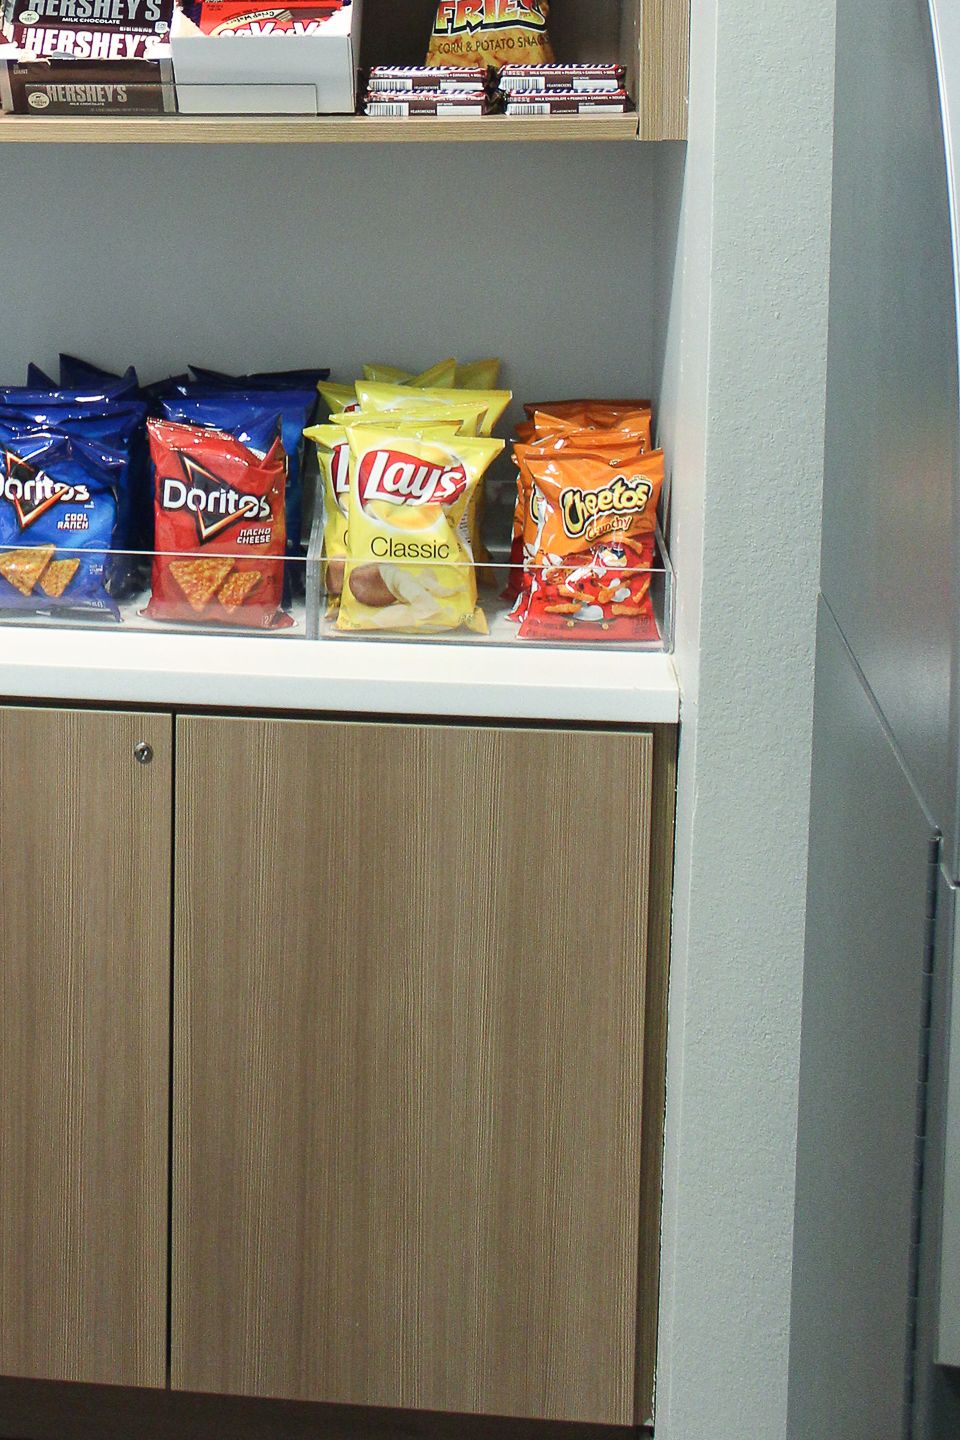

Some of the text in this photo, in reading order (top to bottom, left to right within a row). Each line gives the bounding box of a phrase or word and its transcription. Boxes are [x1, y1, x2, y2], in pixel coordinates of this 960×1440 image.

[25, 27, 163, 60] HERSHEY'S
[437, 41, 463, 54] CORN
[465, 41, 473, 53] &
[475, 38, 515, 52] POTATO
[46, 85, 127, 103] HERSHEY'S
[362, 449, 468, 507] Lay's
[163, 479, 271, 519] Doritos
[561, 476, 652, 535] Cheetos
[57, 521, 89, 530] RANCH
[64, 513, 88, 522] COOL
[236, 534, 272, 545] CHEESE
[239, 527, 271, 537] NACHO
[370, 536, 451, 560] Classic
